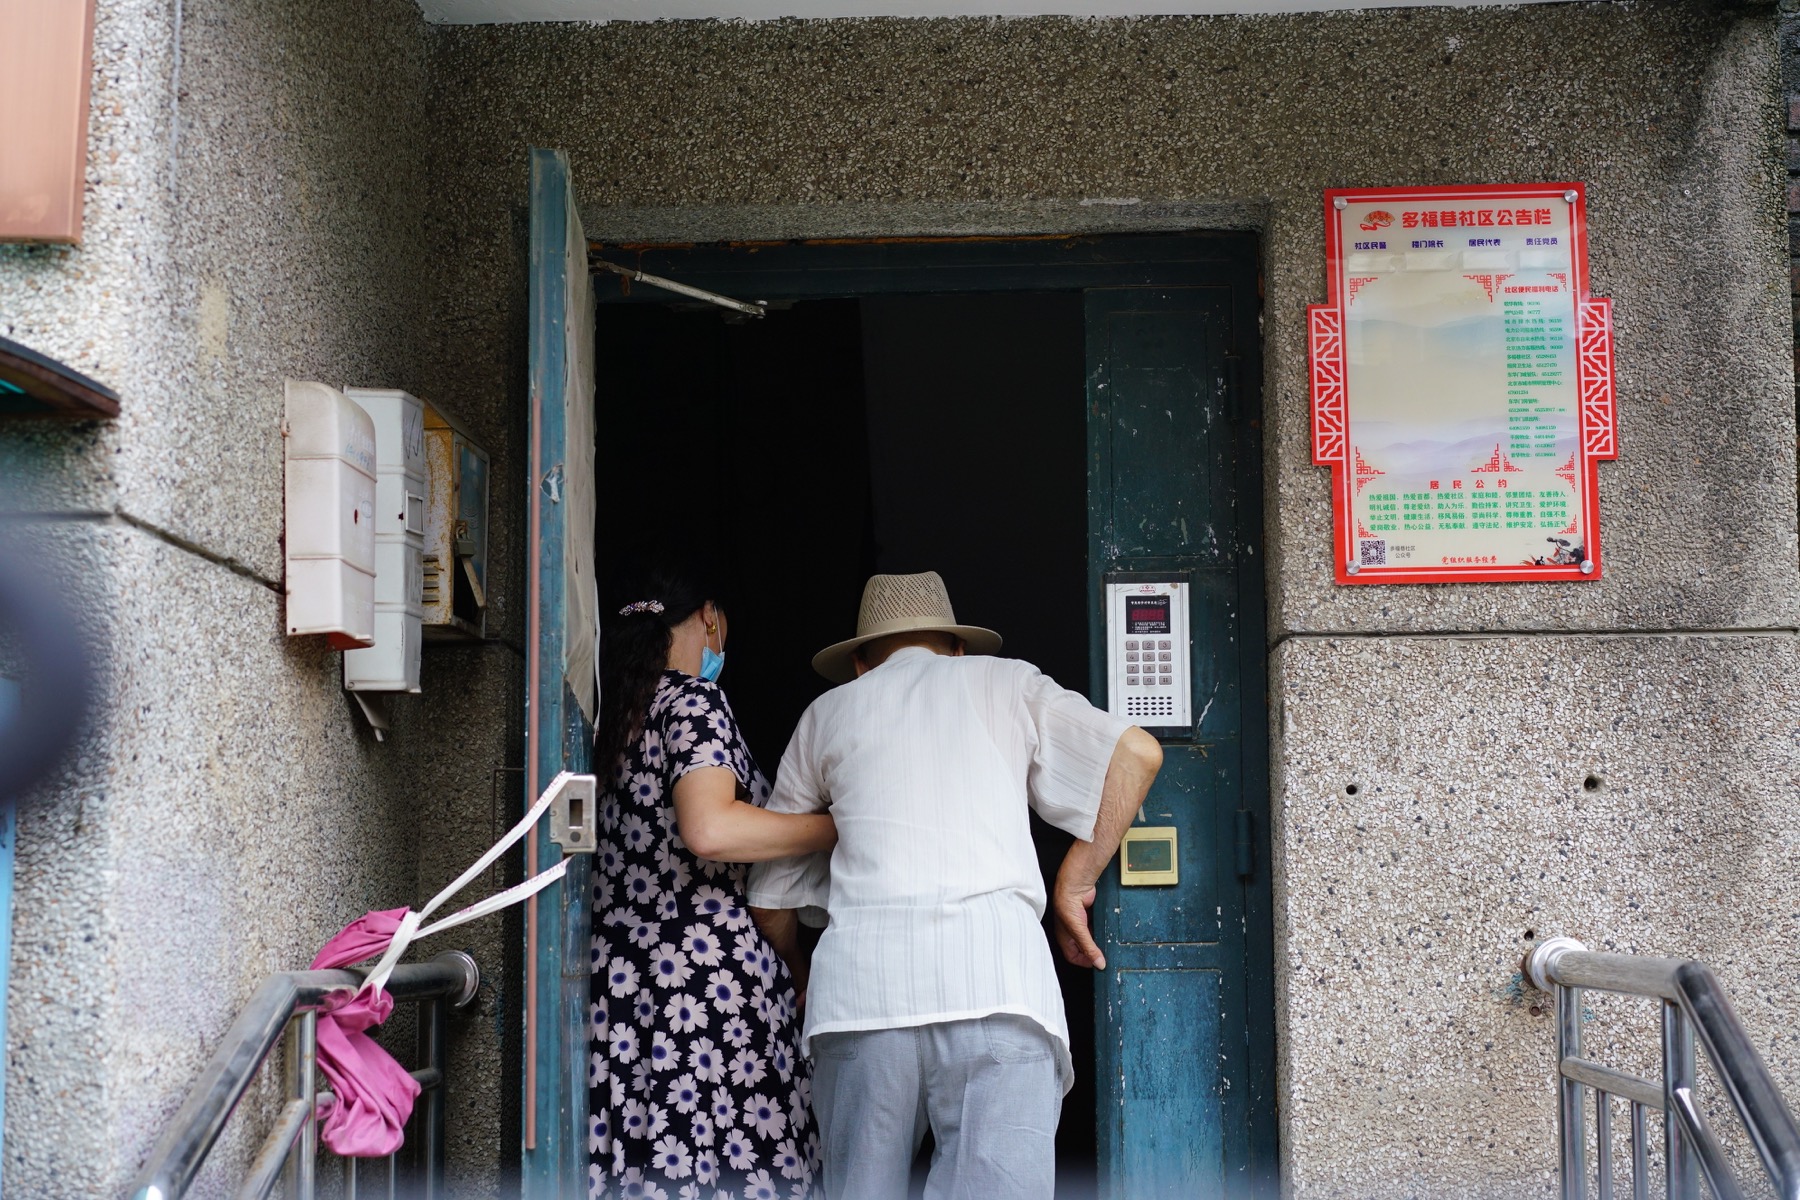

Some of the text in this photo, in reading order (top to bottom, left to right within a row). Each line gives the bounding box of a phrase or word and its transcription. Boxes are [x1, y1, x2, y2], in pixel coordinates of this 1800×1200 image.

[1402, 208, 1552, 228] 多福巷社区公告栏
[1355, 237, 1558, 250] 社区民警 楼门院长 居民代表 责任党员
